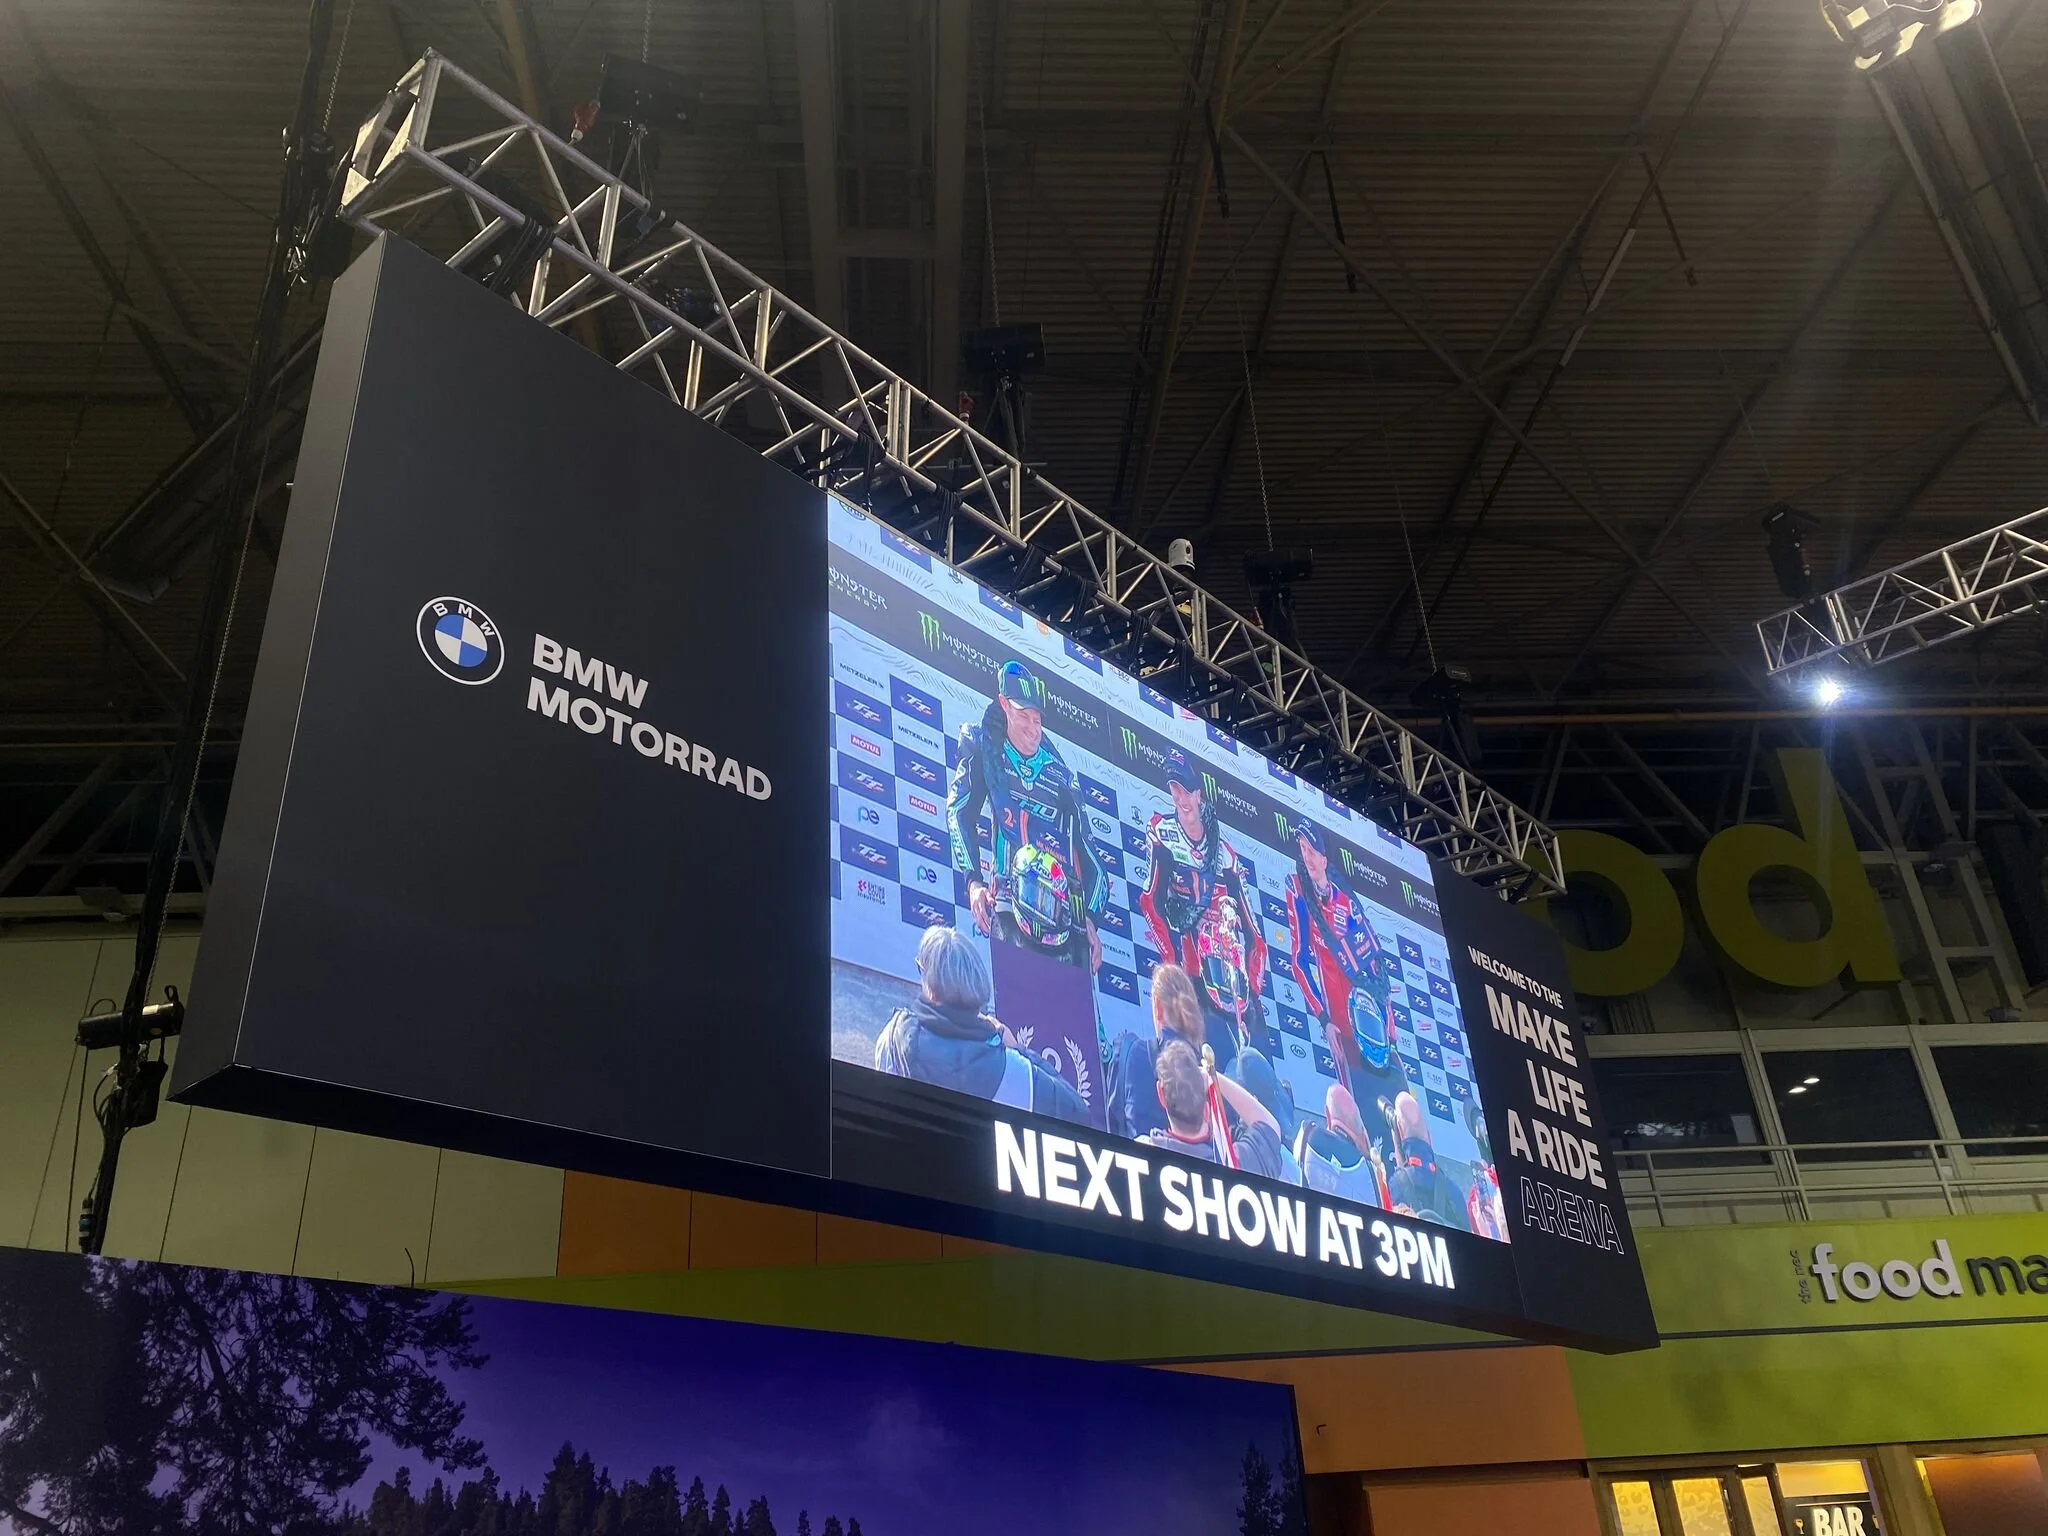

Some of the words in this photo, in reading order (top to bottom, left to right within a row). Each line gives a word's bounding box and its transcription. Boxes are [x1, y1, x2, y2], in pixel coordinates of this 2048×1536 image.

[432, 602, 495, 637] BMW
[533, 633, 648, 709] BMW
[943, 630, 1001, 671] MONSTER
[839, 662, 877, 685] METZELER
[1048, 691, 1099, 727] MONSTER
[1057, 708, 1092, 729] ENERGY
[527, 677, 772, 801] MOTORRAD
[852, 736, 880, 755] MOTUL
[910, 797, 936, 813] MOTUL
[1217, 786, 1258, 816] MONSTER
[1353, 859, 1388, 886] MONSTER
[1467, 945, 1528, 991] WELCOME
[1525, 976, 1542, 998] TO
[1540, 984, 1565, 1010] THE
[1485, 983, 1578, 1068] MAKE
[1526, 1058, 1593, 1128] LIFE
[1507, 1108, 1534, 1163] A
[1532, 1118, 1608, 1190] RIDE
[993, 1119, 1150, 1222] NEXT
[1159, 1164, 1307, 1258] SHOW
[1318, 1208, 1364, 1270] AT
[1370, 1219, 1456, 1290] 3PM
[1520, 1176, 1625, 1255] ARENA
[1811, 1239, 1965, 1301] food
[1812, 1506, 1867, 1536] BAR
